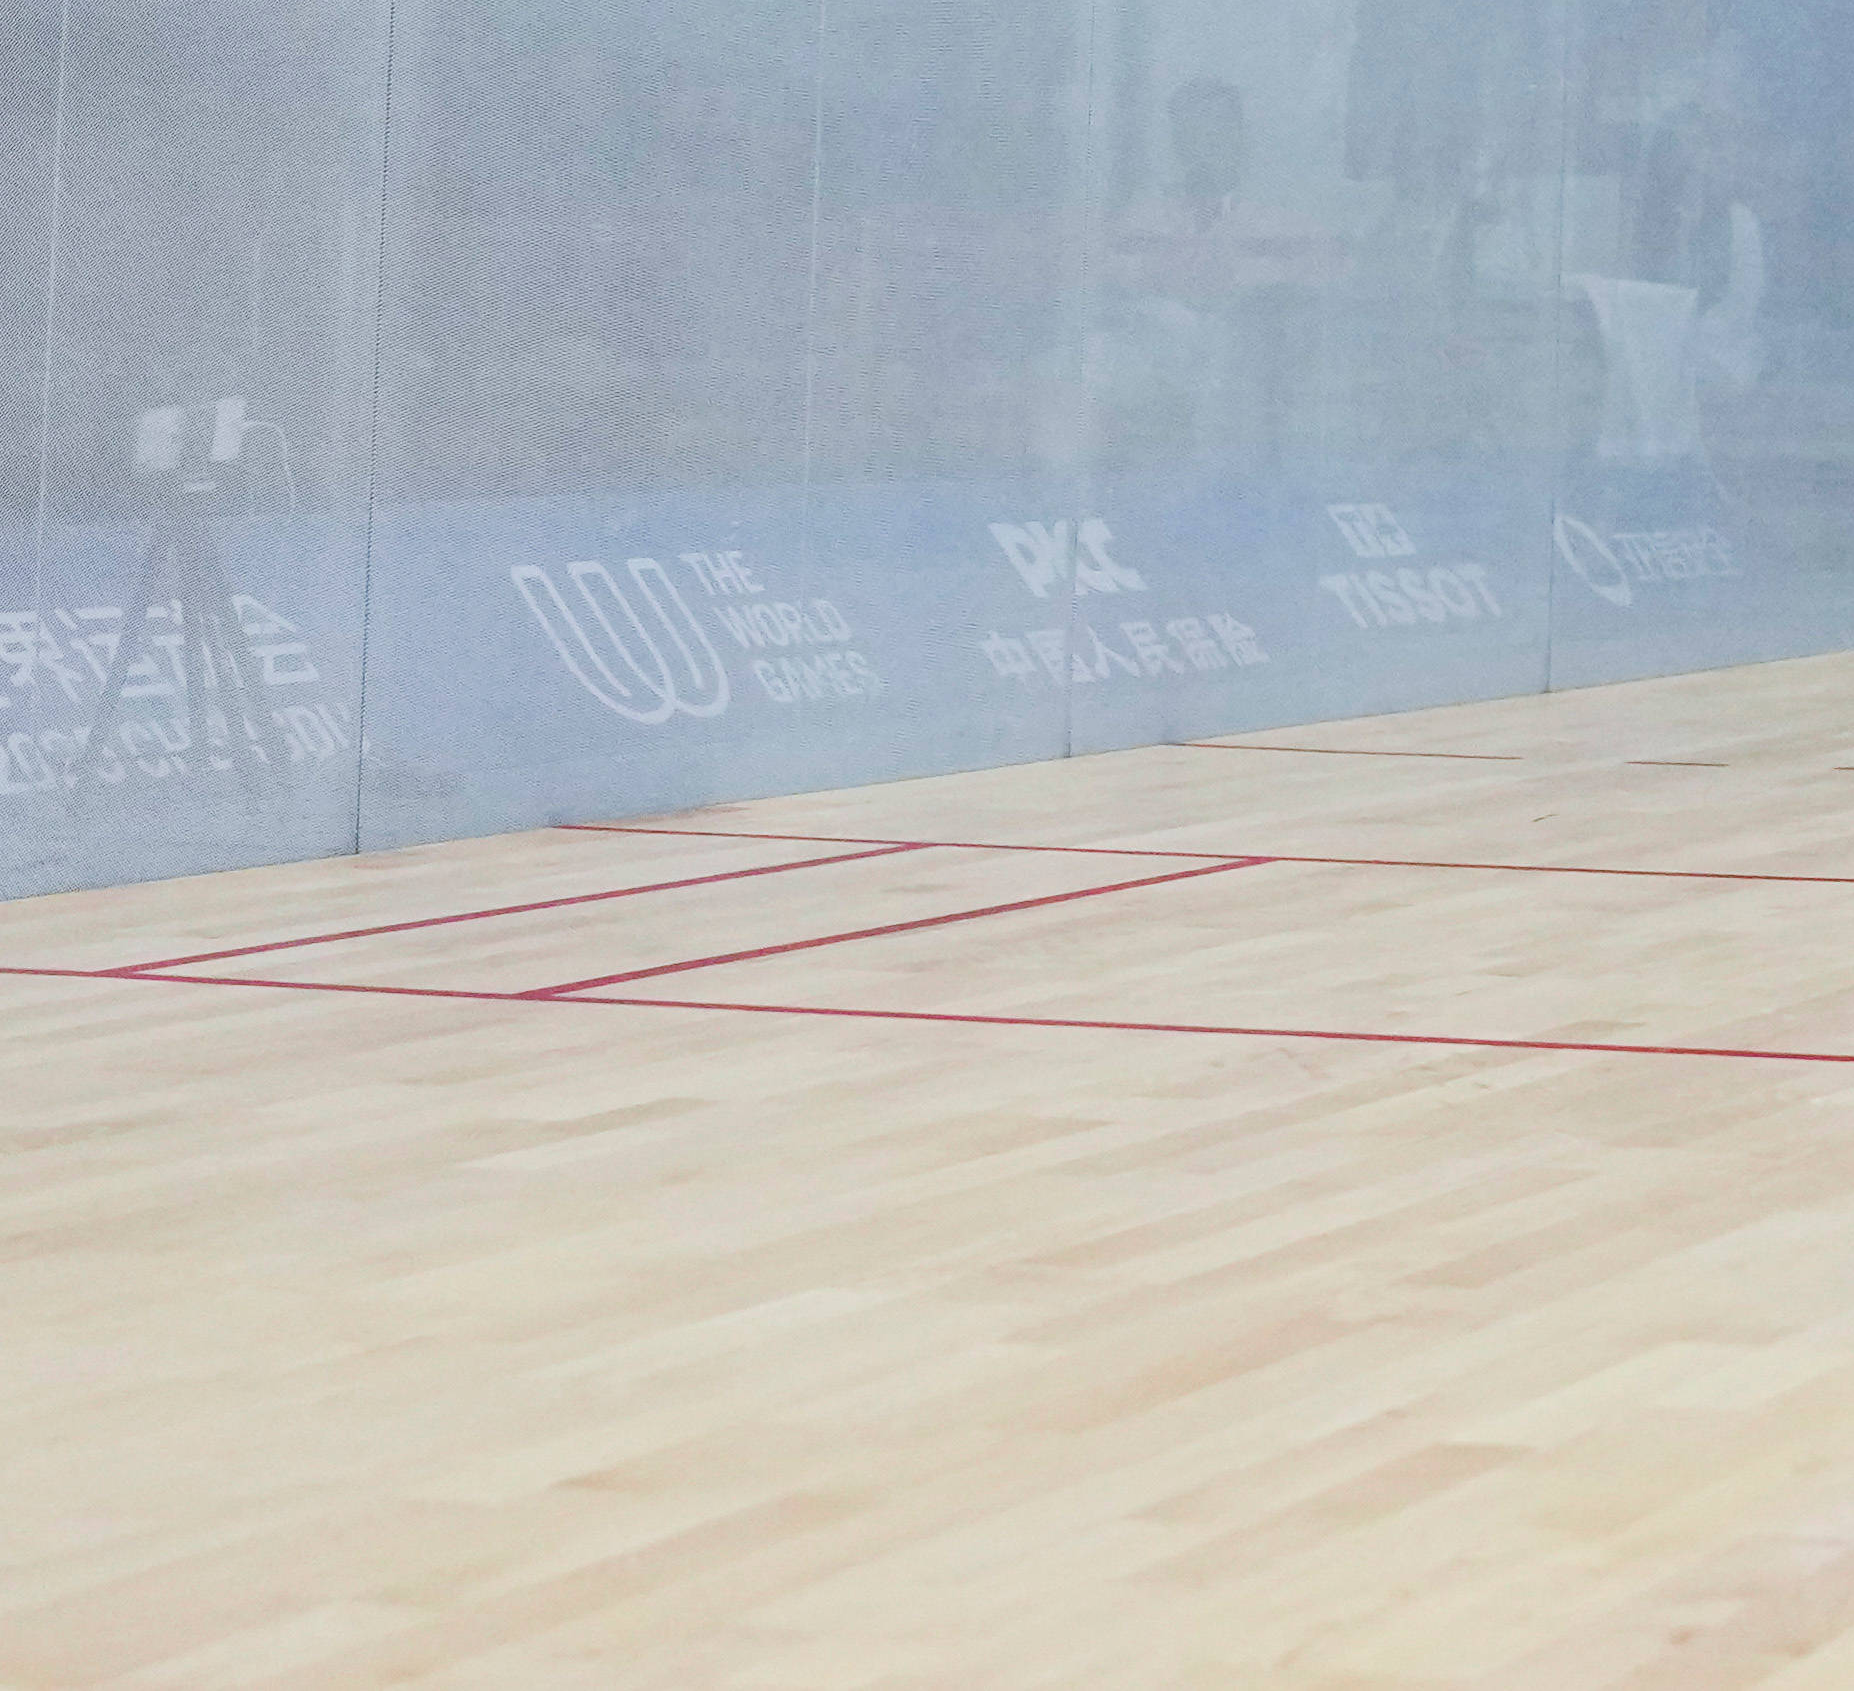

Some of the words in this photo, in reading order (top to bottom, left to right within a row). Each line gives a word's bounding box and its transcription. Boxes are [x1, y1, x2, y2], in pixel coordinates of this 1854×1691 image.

[679, 550, 765, 596] THE
[1318, 562, 1504, 630] TISSOT
[713, 597, 853, 649] WORLD
[753, 650, 879, 703] GAMES
